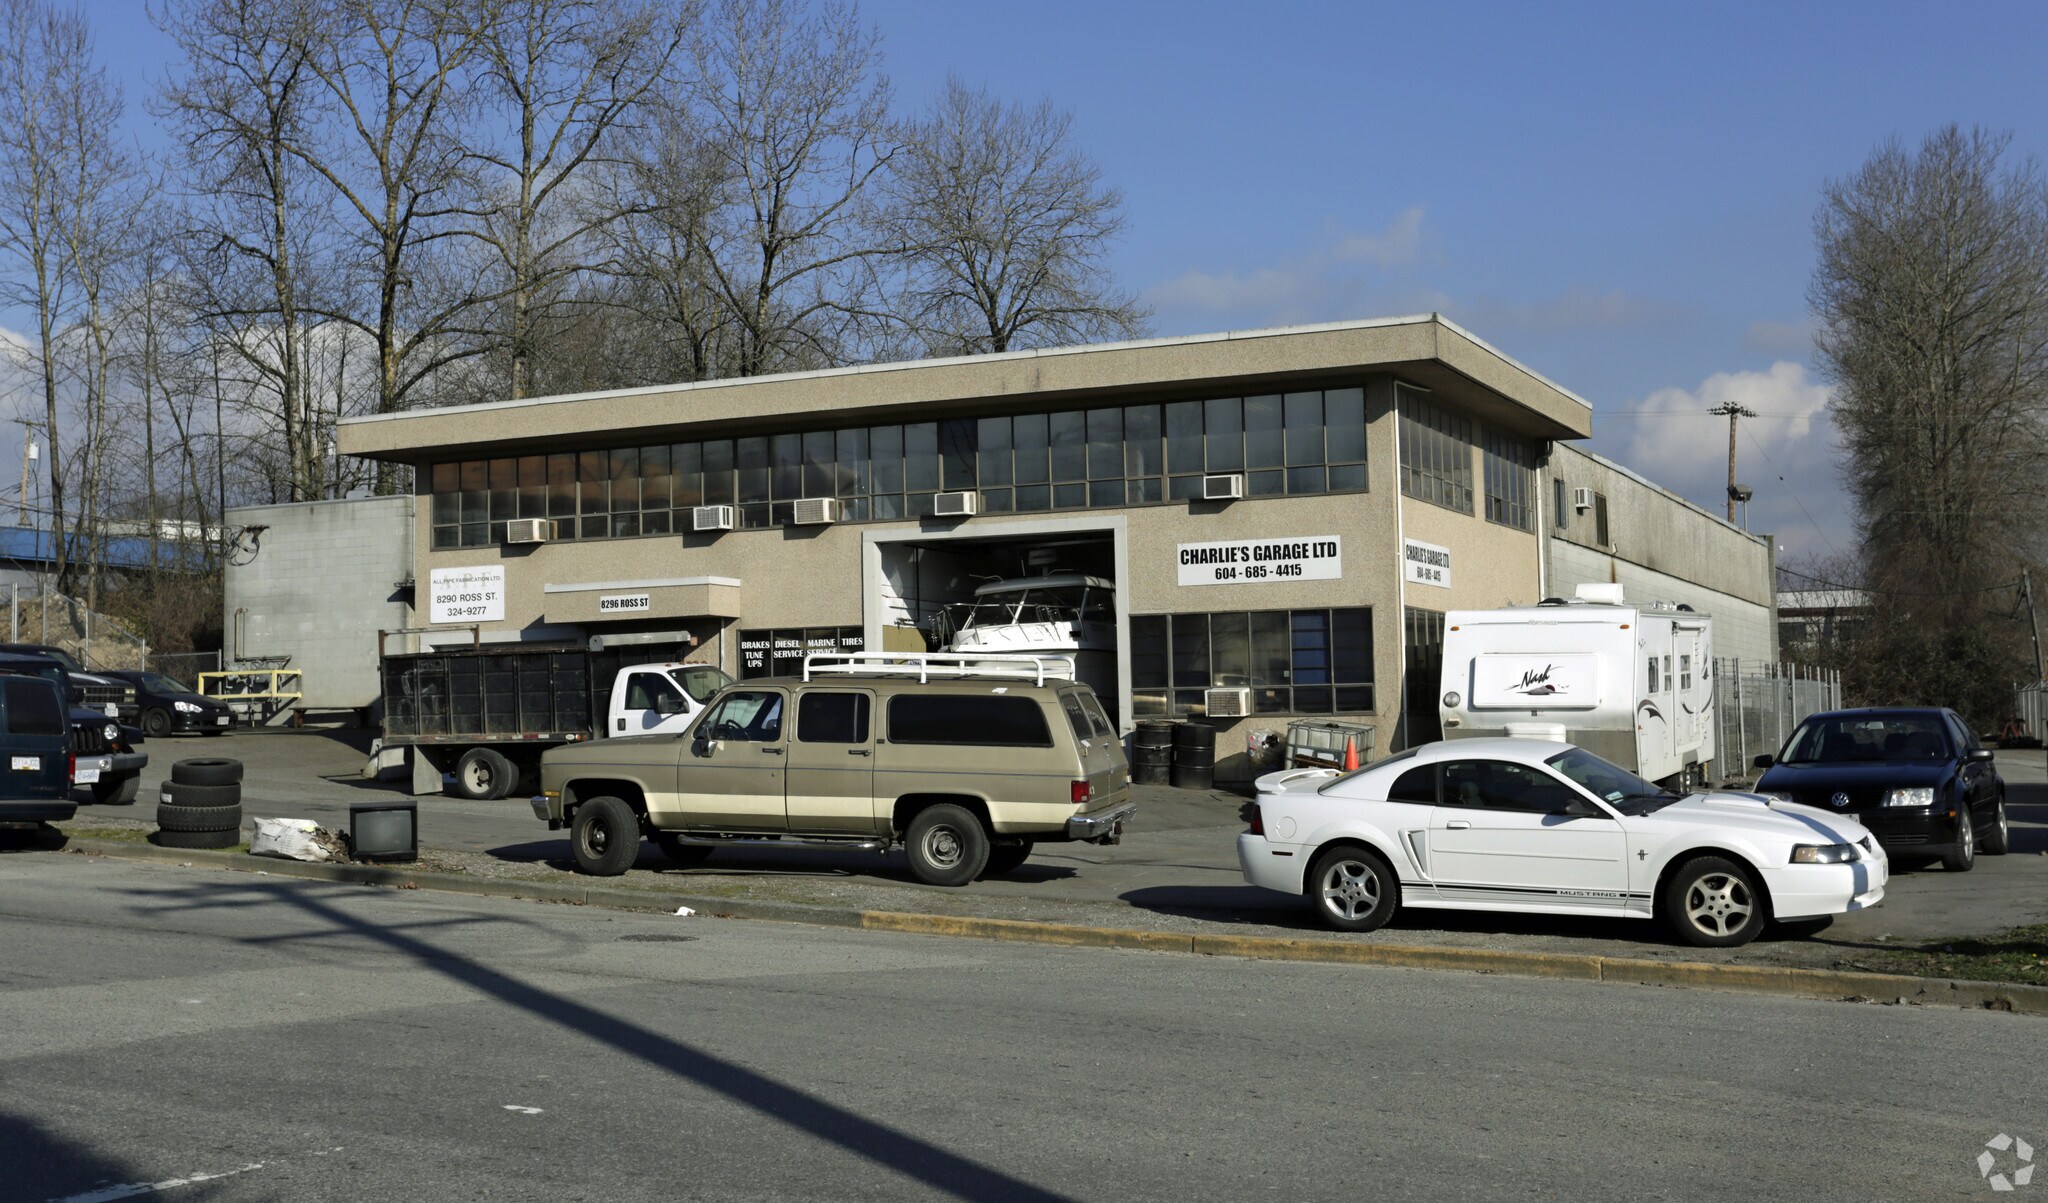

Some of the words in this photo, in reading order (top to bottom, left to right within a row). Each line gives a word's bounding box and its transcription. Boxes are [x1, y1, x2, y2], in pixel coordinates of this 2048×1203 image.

[1180, 546, 1250, 565] CHARLIE'S
[1253, 543, 1309, 561] GARAGE
[1313, 541, 1337, 558] LTD
[436, 595, 457, 604] 8290
[459, 593, 482, 602] ROSS
[601, 599, 619, 609] 8296
[620, 598, 639, 608] ROSS
[639, 597, 649, 607] ST
[447, 606, 487, 617] 324-9277
[741, 641, 770, 649] BRAKES
[775, 639, 801, 648] DIESEL
[807, 638, 836, 647] MARINE
[841, 637, 863, 646] TIRES
[745, 651, 764, 659] TUNE
[773, 649, 804, 658] SERVICE
[747, 659, 763, 668] UPS
[1520, 663, 1552, 690] Nash
